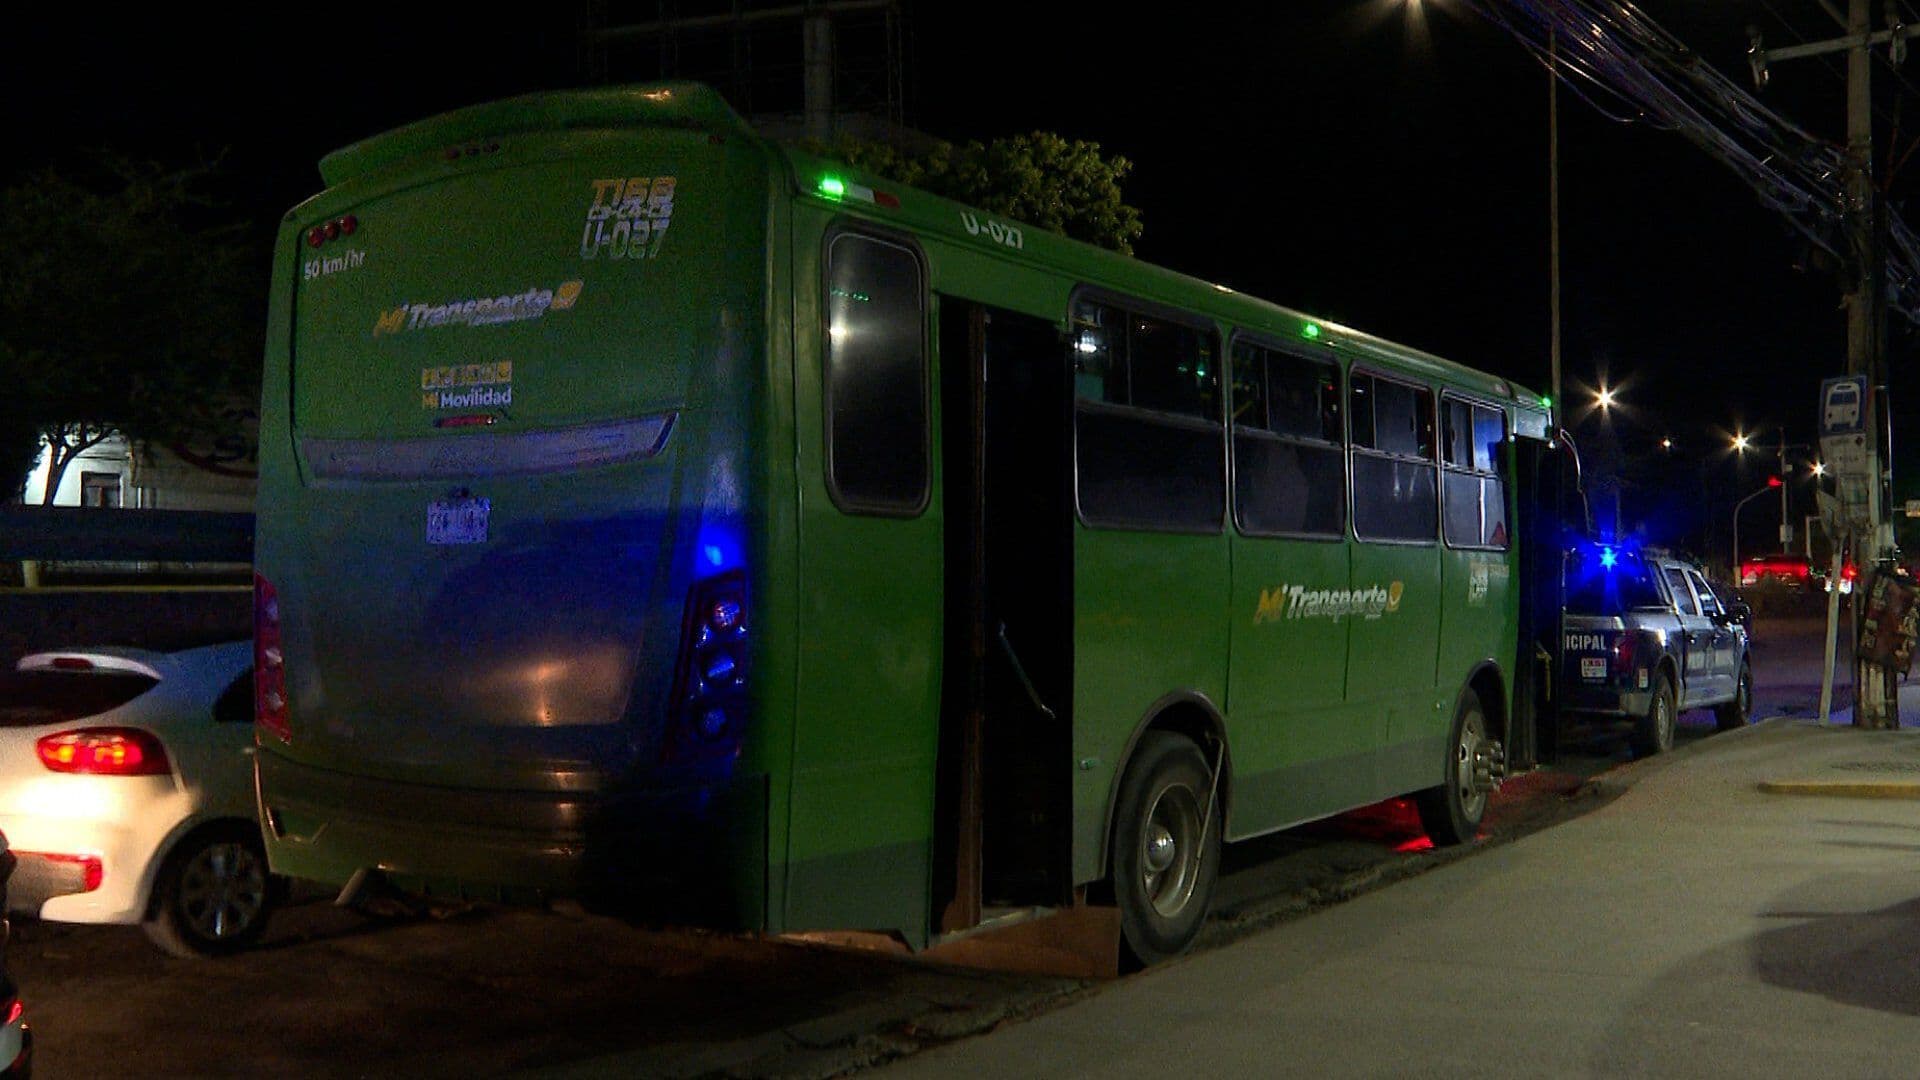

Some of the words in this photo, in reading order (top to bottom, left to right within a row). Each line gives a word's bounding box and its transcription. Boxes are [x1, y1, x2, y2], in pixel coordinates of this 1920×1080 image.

[960, 212, 1023, 249] U-027
[304, 261, 320, 280] 50
[322, 249, 366, 273] km/hr
[440, 386, 512, 409] Movilidad
[1286, 583, 1388, 624] Transporte
[1565, 634, 1607, 650] ICIPAL
